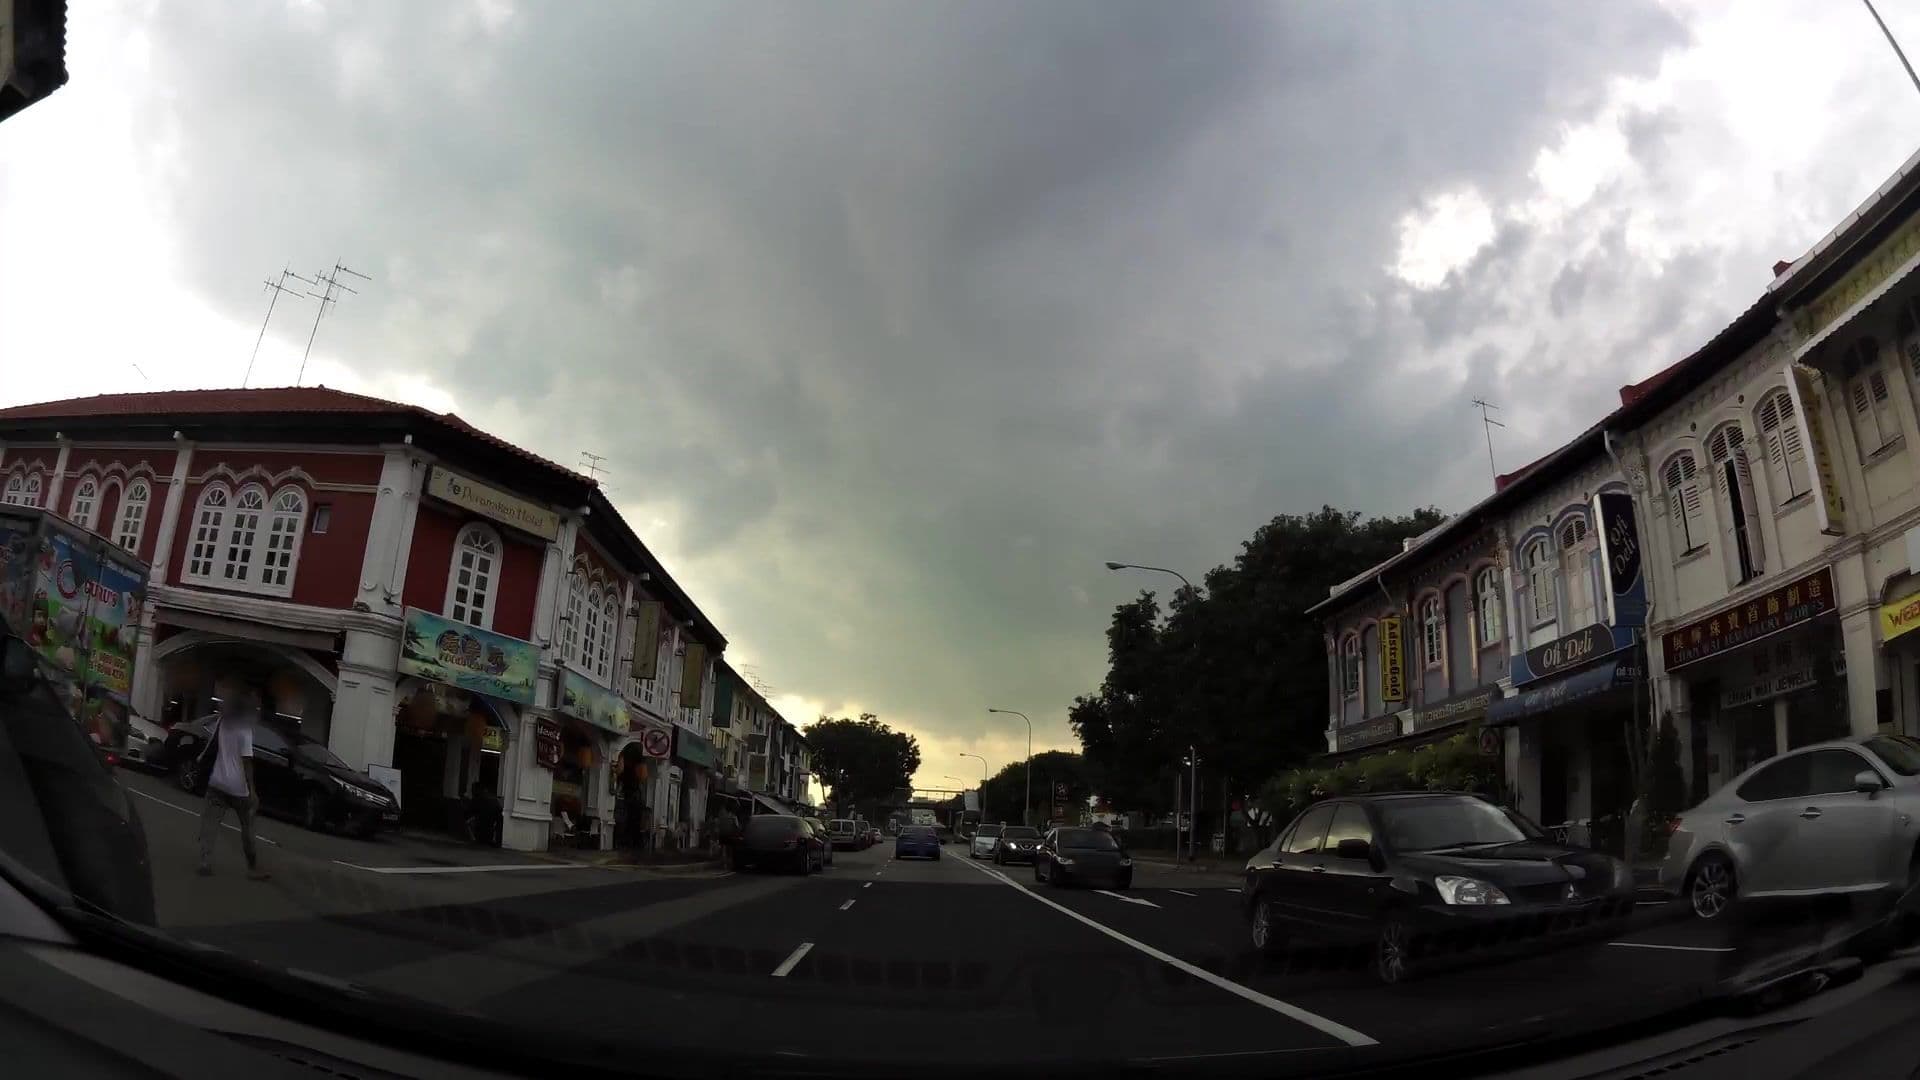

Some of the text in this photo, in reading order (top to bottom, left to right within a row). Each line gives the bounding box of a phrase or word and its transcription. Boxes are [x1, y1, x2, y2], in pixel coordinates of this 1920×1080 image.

[517, 507, 543, 527] Hotel
[1615, 537, 1636, 575] Deli
[1565, 630, 1593, 660] Deli
